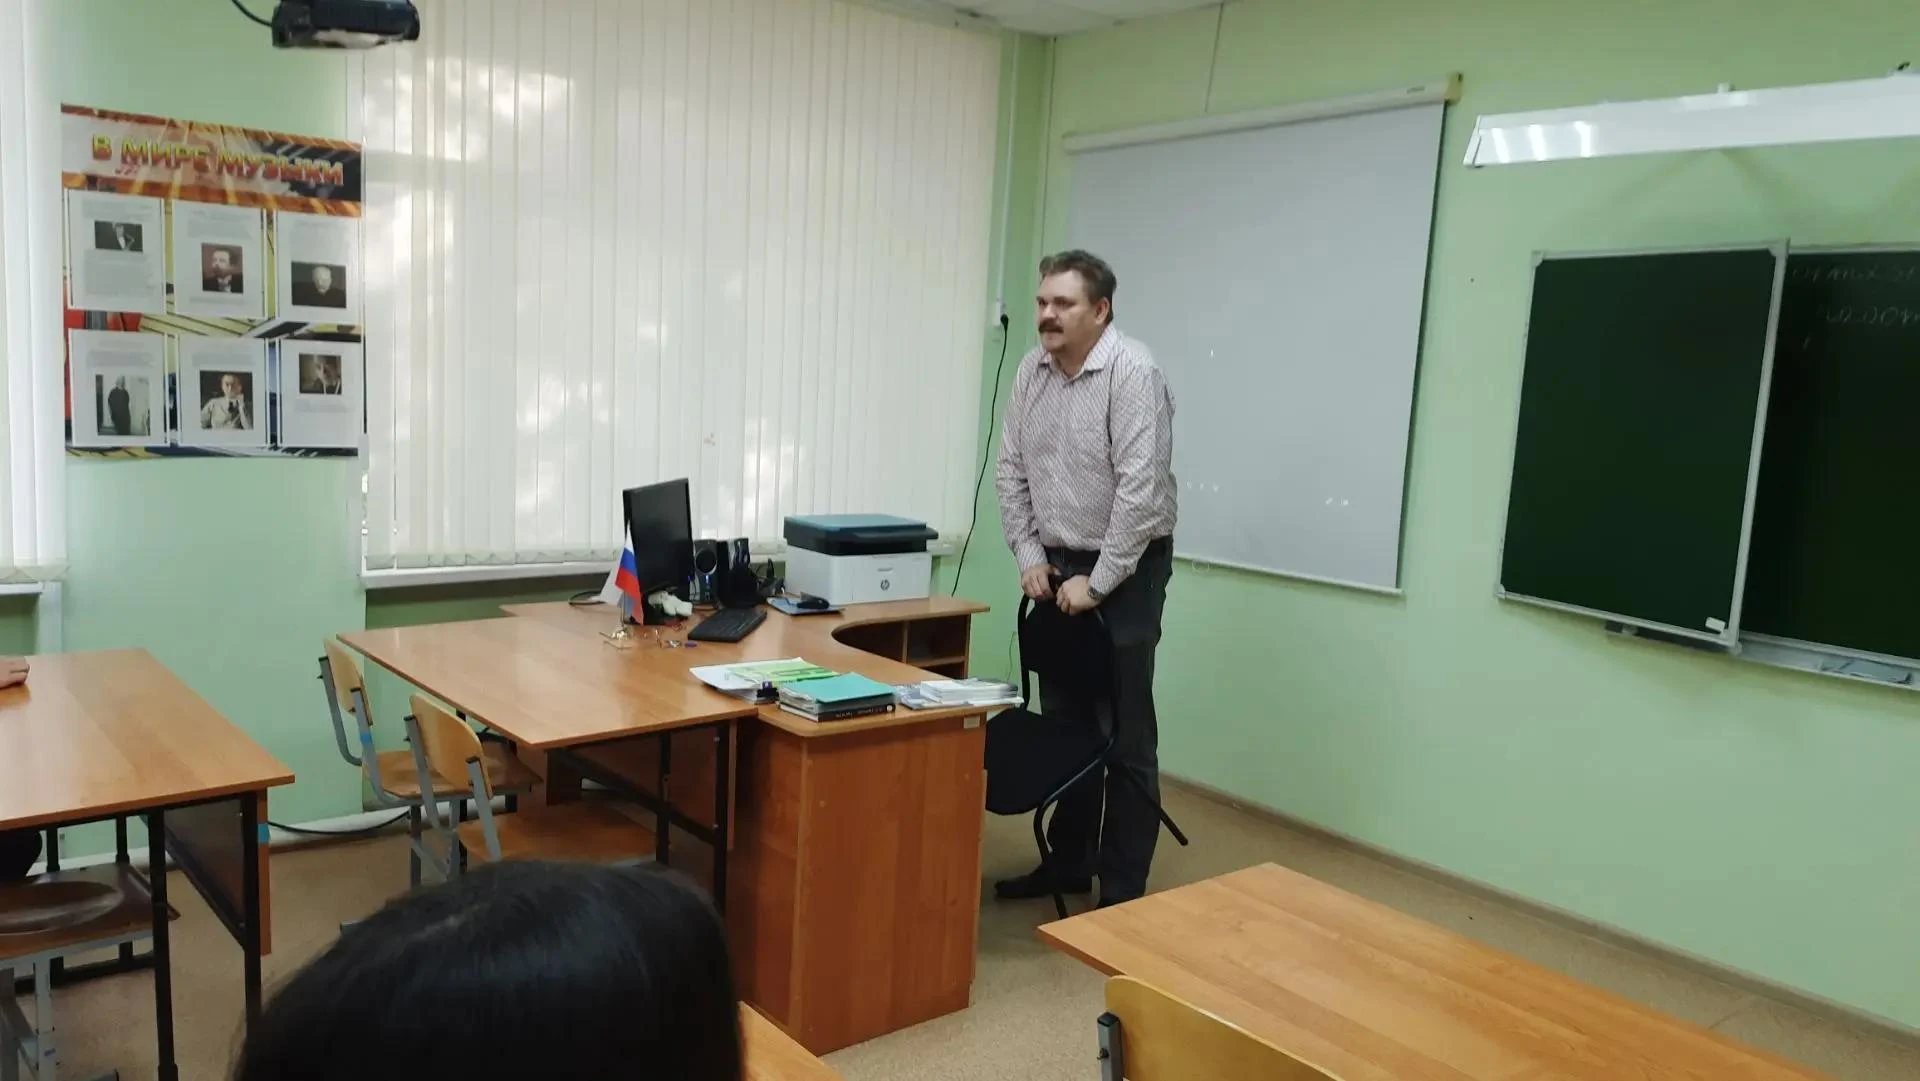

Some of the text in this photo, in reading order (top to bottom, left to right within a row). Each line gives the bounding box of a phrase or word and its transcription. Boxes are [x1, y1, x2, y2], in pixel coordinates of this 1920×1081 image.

[92, 134, 345, 186] В МИРЕ МУЗЫКИ
